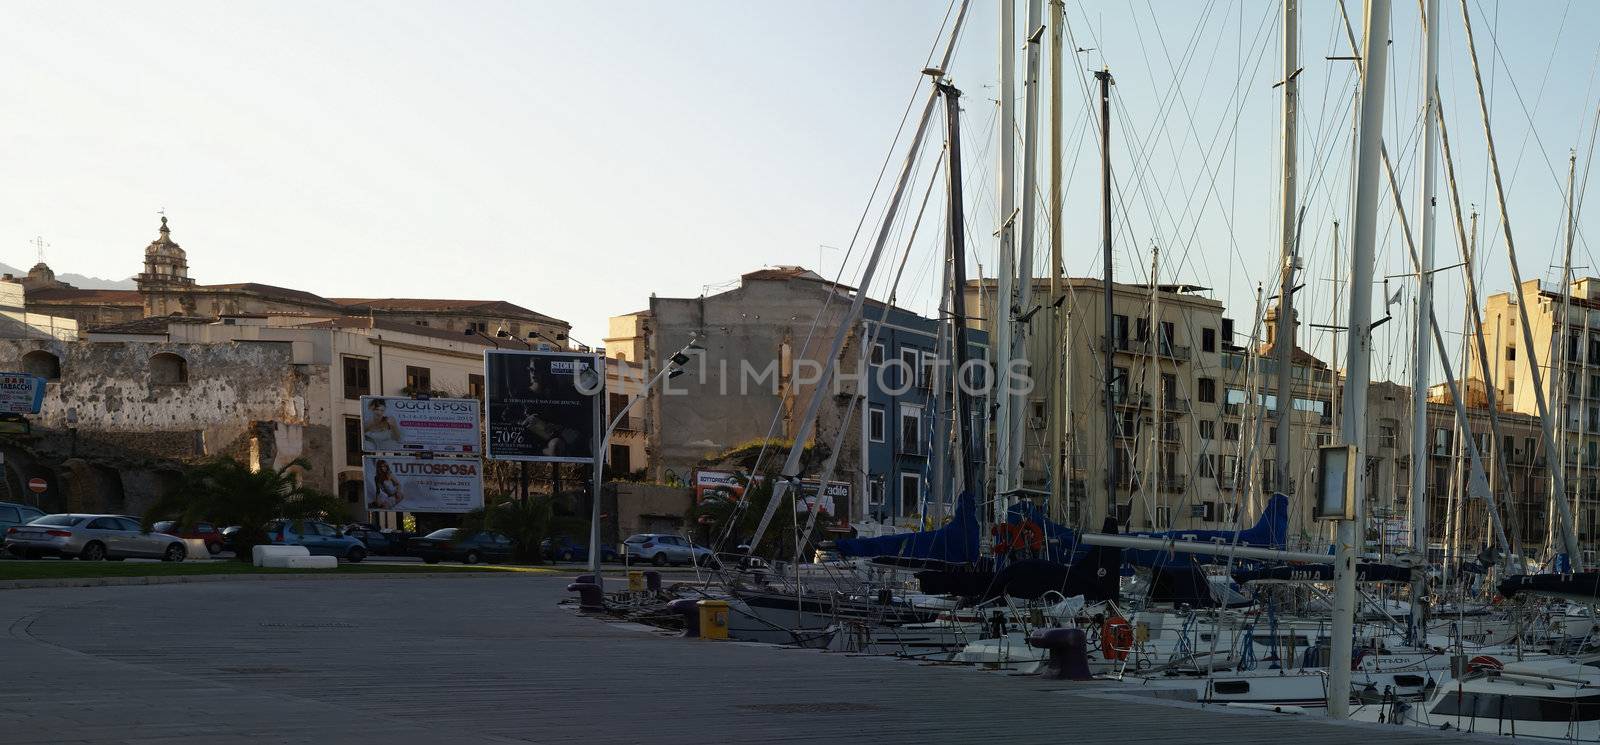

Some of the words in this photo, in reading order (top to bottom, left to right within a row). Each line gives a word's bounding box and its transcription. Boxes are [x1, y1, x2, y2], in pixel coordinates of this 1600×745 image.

[395, 400, 430, 410] OGGI
[433, 402, 472, 412] SPOSI
[491, 431, 525, 444] -70%
[392, 463, 477, 475] TUTTOSPOSA
